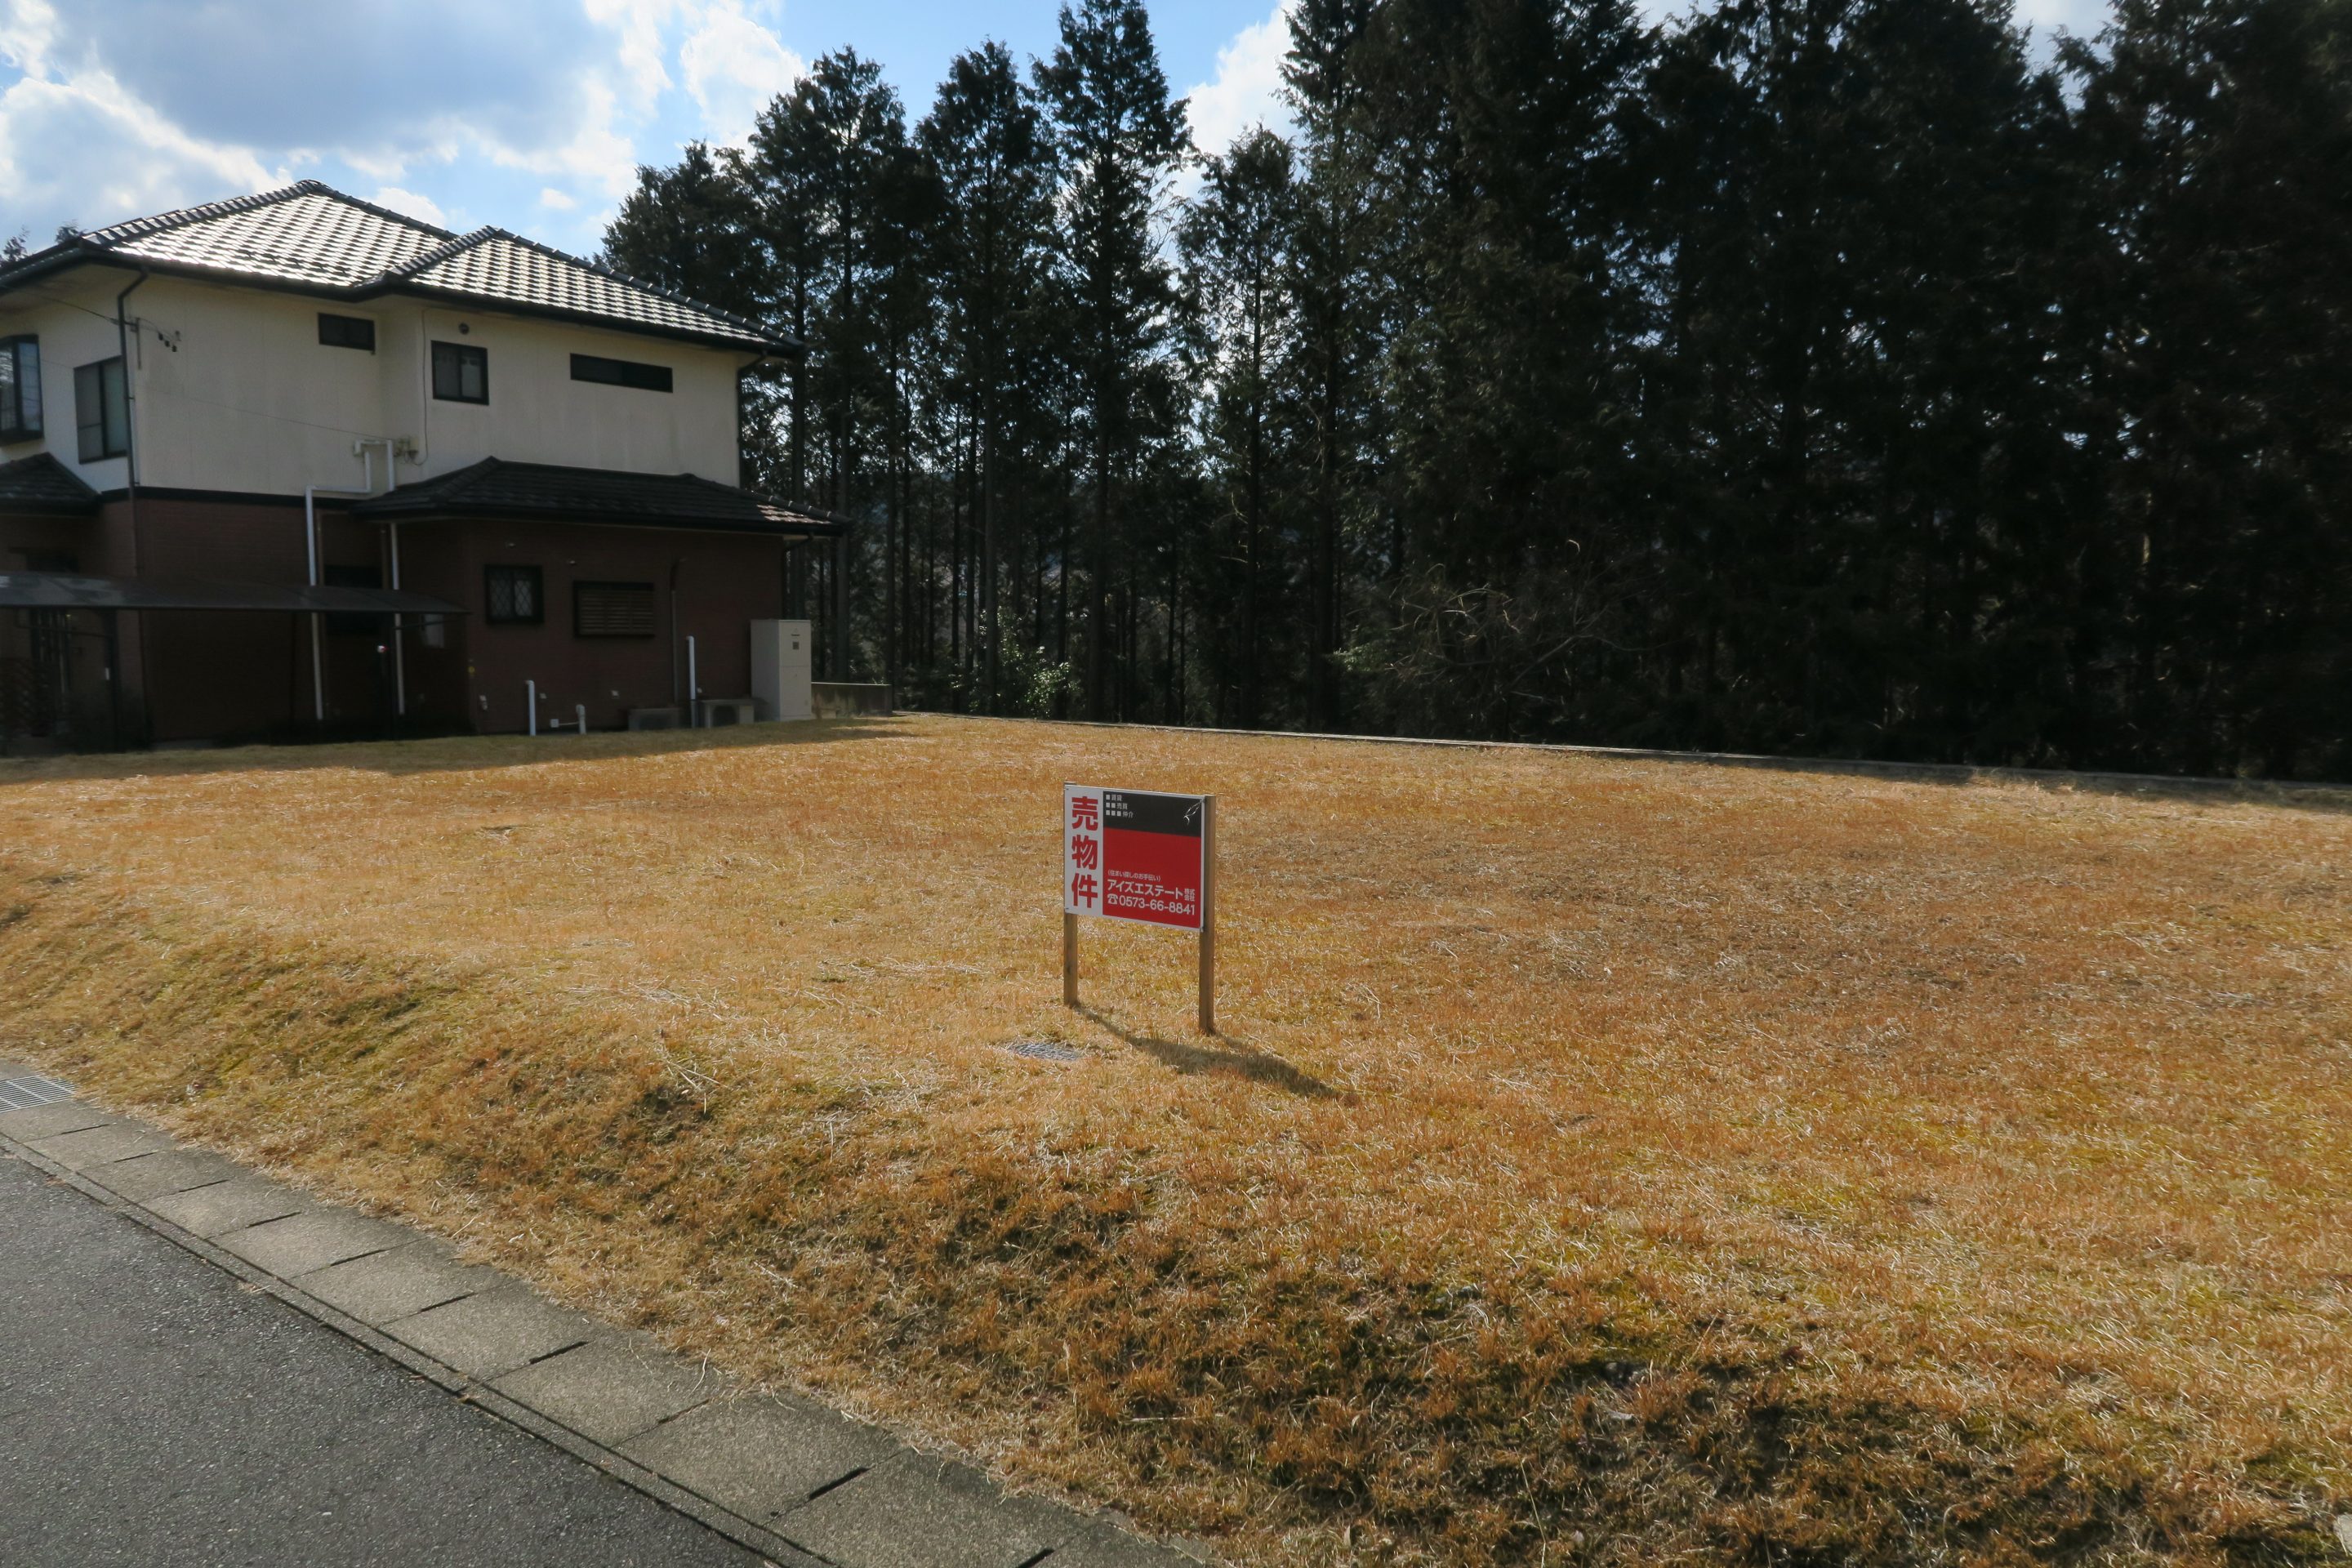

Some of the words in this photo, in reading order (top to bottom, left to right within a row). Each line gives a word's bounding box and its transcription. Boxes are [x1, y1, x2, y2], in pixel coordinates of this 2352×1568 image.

[1071, 796, 1098, 909] 売物件
[1119, 894, 1195, 915] 0573-66-8841
